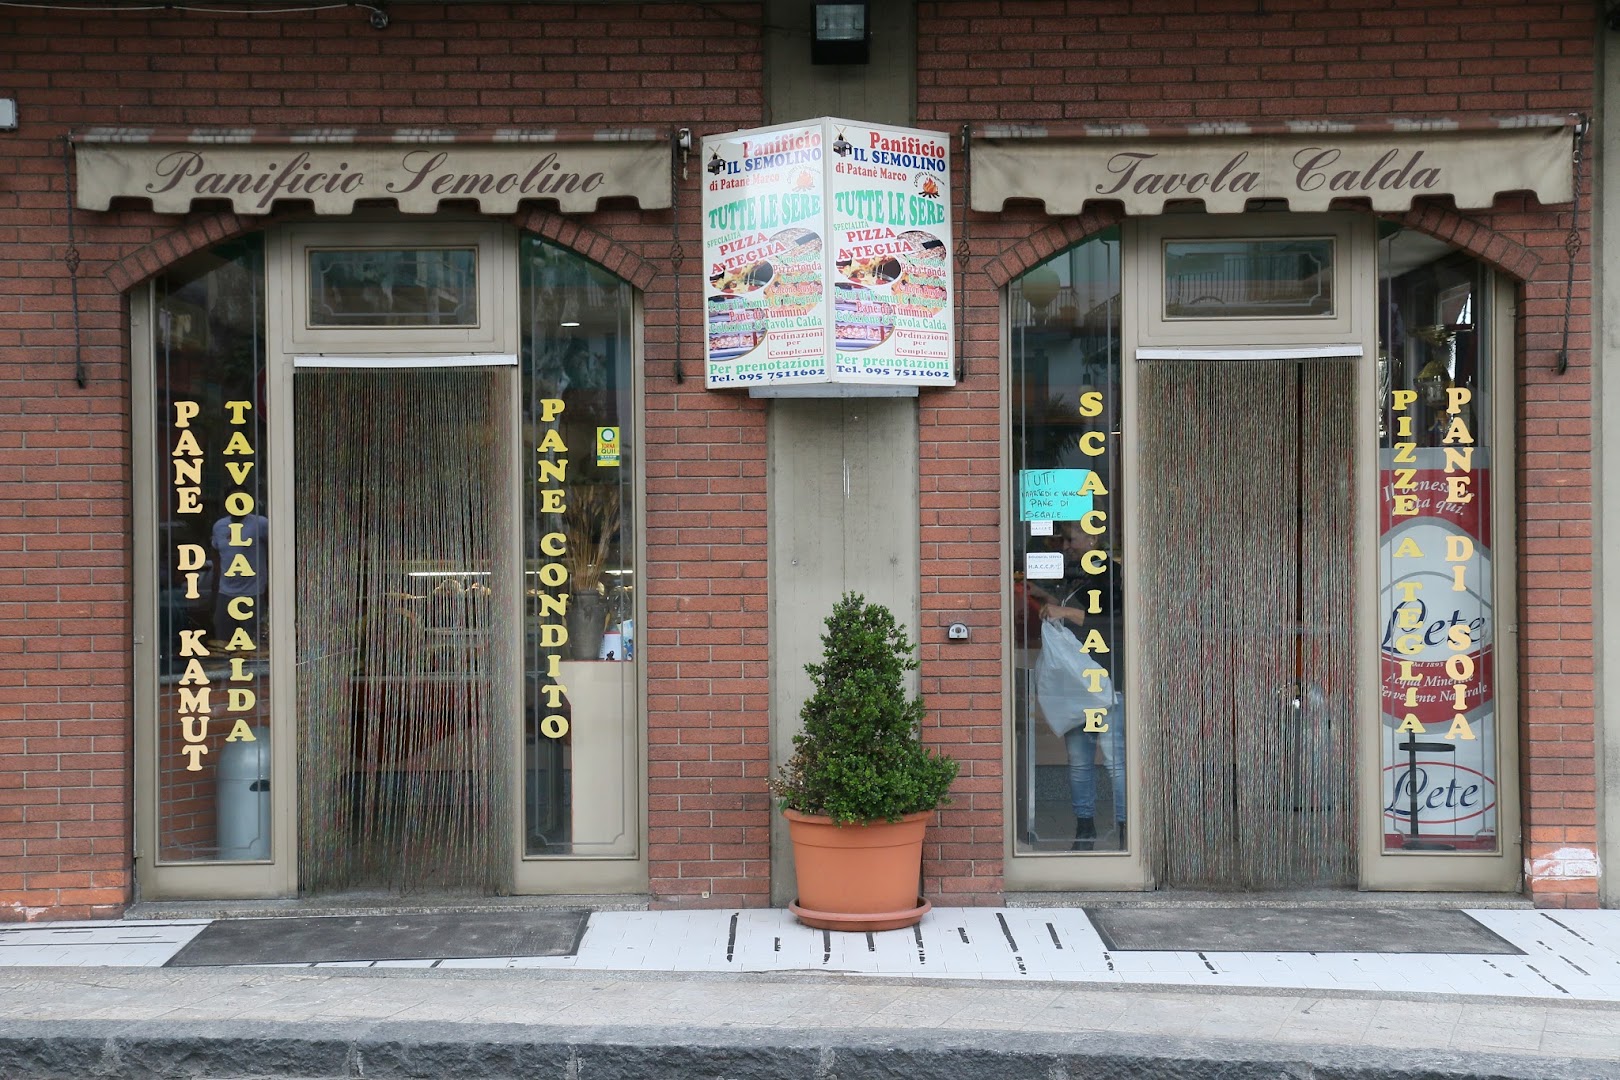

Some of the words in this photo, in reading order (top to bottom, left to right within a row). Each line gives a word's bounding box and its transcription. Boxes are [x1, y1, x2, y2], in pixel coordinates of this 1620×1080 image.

[743, 130, 821, 158] Panificio
[869, 132, 945, 158] Panificio
[727, 161, 741, 174] IL
[744, 148, 822, 172] SEMOLINO
[836, 162, 844, 174] di
[846, 163, 878, 178] Patanè
[880, 167, 907, 182] Marco
[854, 148, 868, 162] IL
[872, 150, 946, 172] SEMOLINO
[1096, 151, 1261, 195] Tavola
[1292, 146, 1441, 192] Calda
[146, 150, 364, 208] Panificio
[386, 150, 605, 195] Semolino
[710, 180, 718, 192] di
[753, 174, 780, 186] Marco
[708, 197, 756, 230] TUTTE
[760, 194, 778, 230] LE
[782, 192, 821, 226] SERE
[835, 190, 884, 224] TUTTE
[887, 190, 906, 226] LE
[909, 194, 945, 226] SERE
[719, 232, 768, 256] PIZZA
[846, 227, 896, 242] PIZZA
[712, 262, 722, 274] A
[724, 242, 786, 270] TEGLIA
[838, 248, 850, 260] A
[852, 240, 913, 258] TEGLIA
[772, 264, 795, 274] Pizza
[900, 262, 921, 275] Pizza
[729, 310, 750, 321] Pane
[753, 308, 762, 320] di
[764, 308, 808, 318] Tummina
[856, 302, 880, 314] Pane
[881, 304, 890, 314] di
[892, 304, 933, 318] Tummina
[764, 318, 794, 330] Tavola
[796, 316, 822, 327] Calda
[770, 330, 823, 340] Ordinazioni
[892, 316, 921, 328] Tavola
[922, 318, 947, 330] Calda
[896, 331, 948, 341] Ordinazioni
[770, 348, 822, 356] Compleanni
[836, 354, 858, 365] Per
[863, 356, 949, 370] prenotazioni
[896, 348, 946, 356] Compleanni
[710, 364, 732, 374] Per
[736, 356, 824, 375] prenotazioni
[710, 374, 734, 382] Tel.
[768, 369, 825, 380] 7511602
[836, 365, 861, 374] Tel.
[866, 367, 890, 375] 095
[894, 368, 950, 378] 7511602
[172, 400, 204, 514] PANE
[537, 399, 568, 514] PANE
[1392, 390, 1420, 516] PIZZE
[1442, 388, 1474, 504] PANE
[222, 400, 256, 577] TAVOLA
[1029, 498, 1054, 508] PANE
[1392, 538, 1424, 558] A
[177, 544, 206, 599] DI
[1078, 392, 1110, 733] SCACCIATE
[1445, 536, 1474, 592] DI
[538, 532, 570, 738] CONDITO
[224, 596, 257, 742] CALDA
[1395, 582, 1426, 733] TEGLIA
[1444, 624, 1476, 740] SOIA
[178, 630, 212, 772] KAMUT
[1384, 768, 1479, 816] Lete
